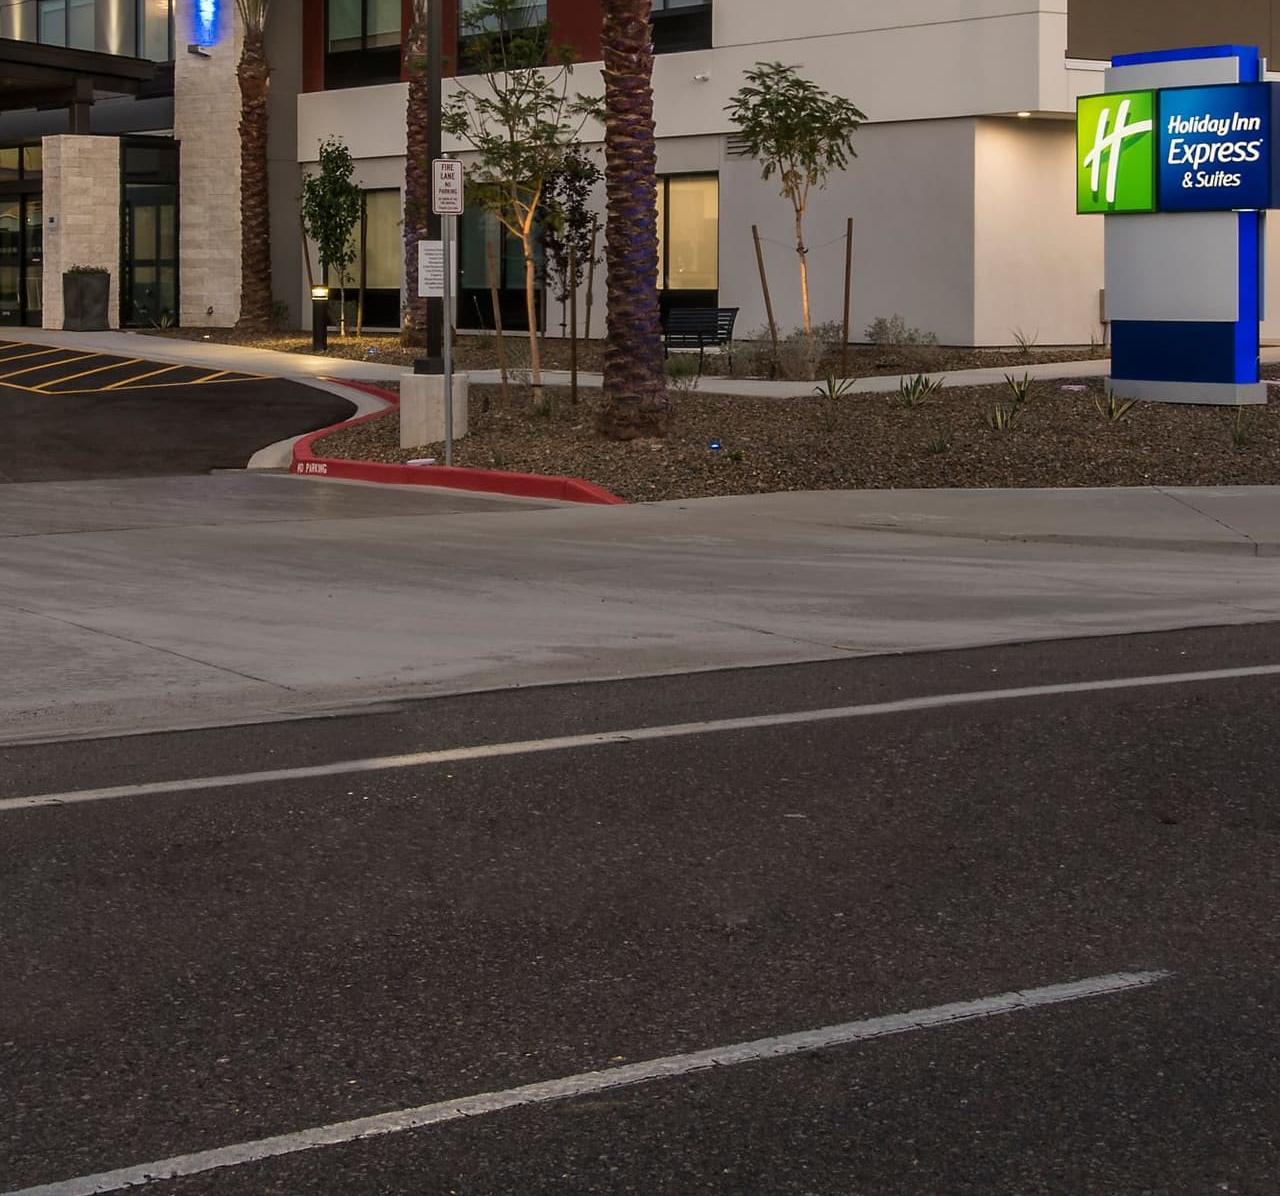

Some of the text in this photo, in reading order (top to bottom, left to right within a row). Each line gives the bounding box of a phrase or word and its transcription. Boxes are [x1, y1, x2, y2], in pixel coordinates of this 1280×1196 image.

[1168, 112, 1261, 136] Holiday Inn
[1168, 139, 1261, 170] Express
[441, 163, 454, 171] FIRE
[440, 172, 455, 180] LANE
[1182, 171, 1241, 188] & Suites
